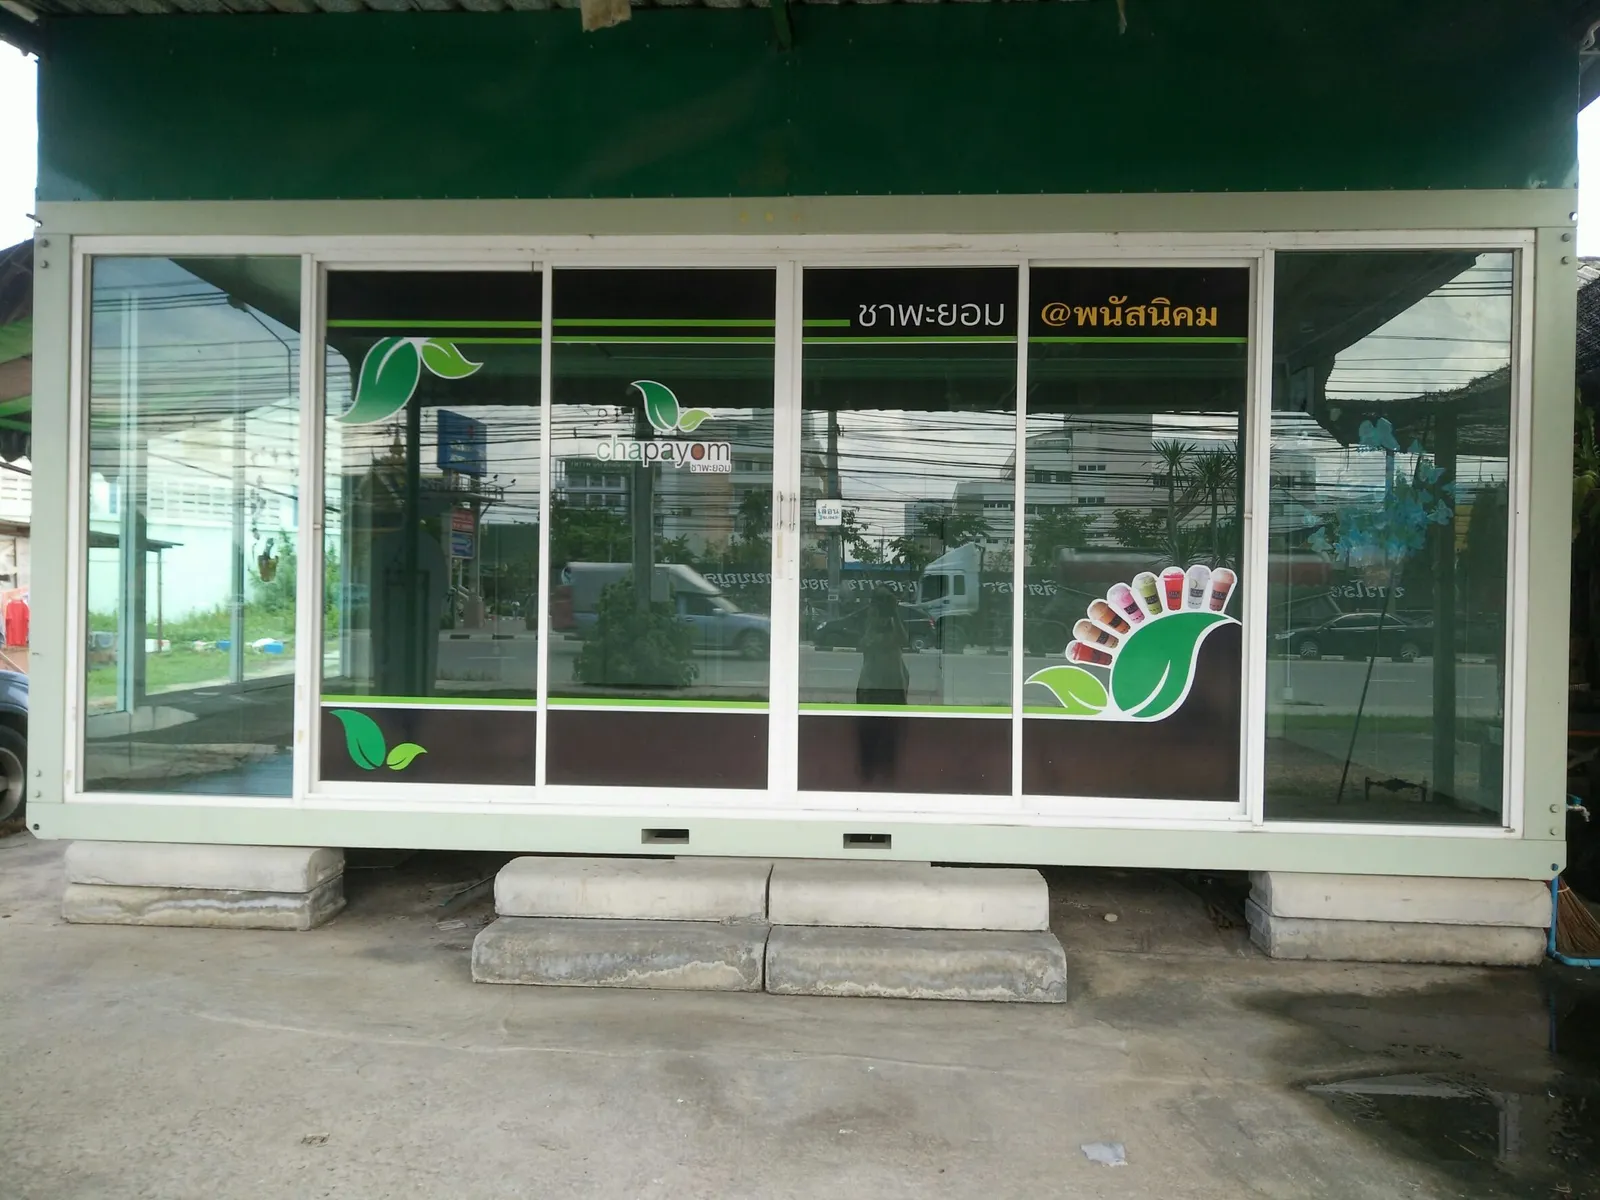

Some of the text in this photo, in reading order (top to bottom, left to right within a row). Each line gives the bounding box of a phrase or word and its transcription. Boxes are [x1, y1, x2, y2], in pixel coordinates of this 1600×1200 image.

[858, 302, 1005, 327] ชาพะยอม
[1040, 295, 1218, 327] @พนัสนิคม
[598, 436, 730, 467] chapayom
